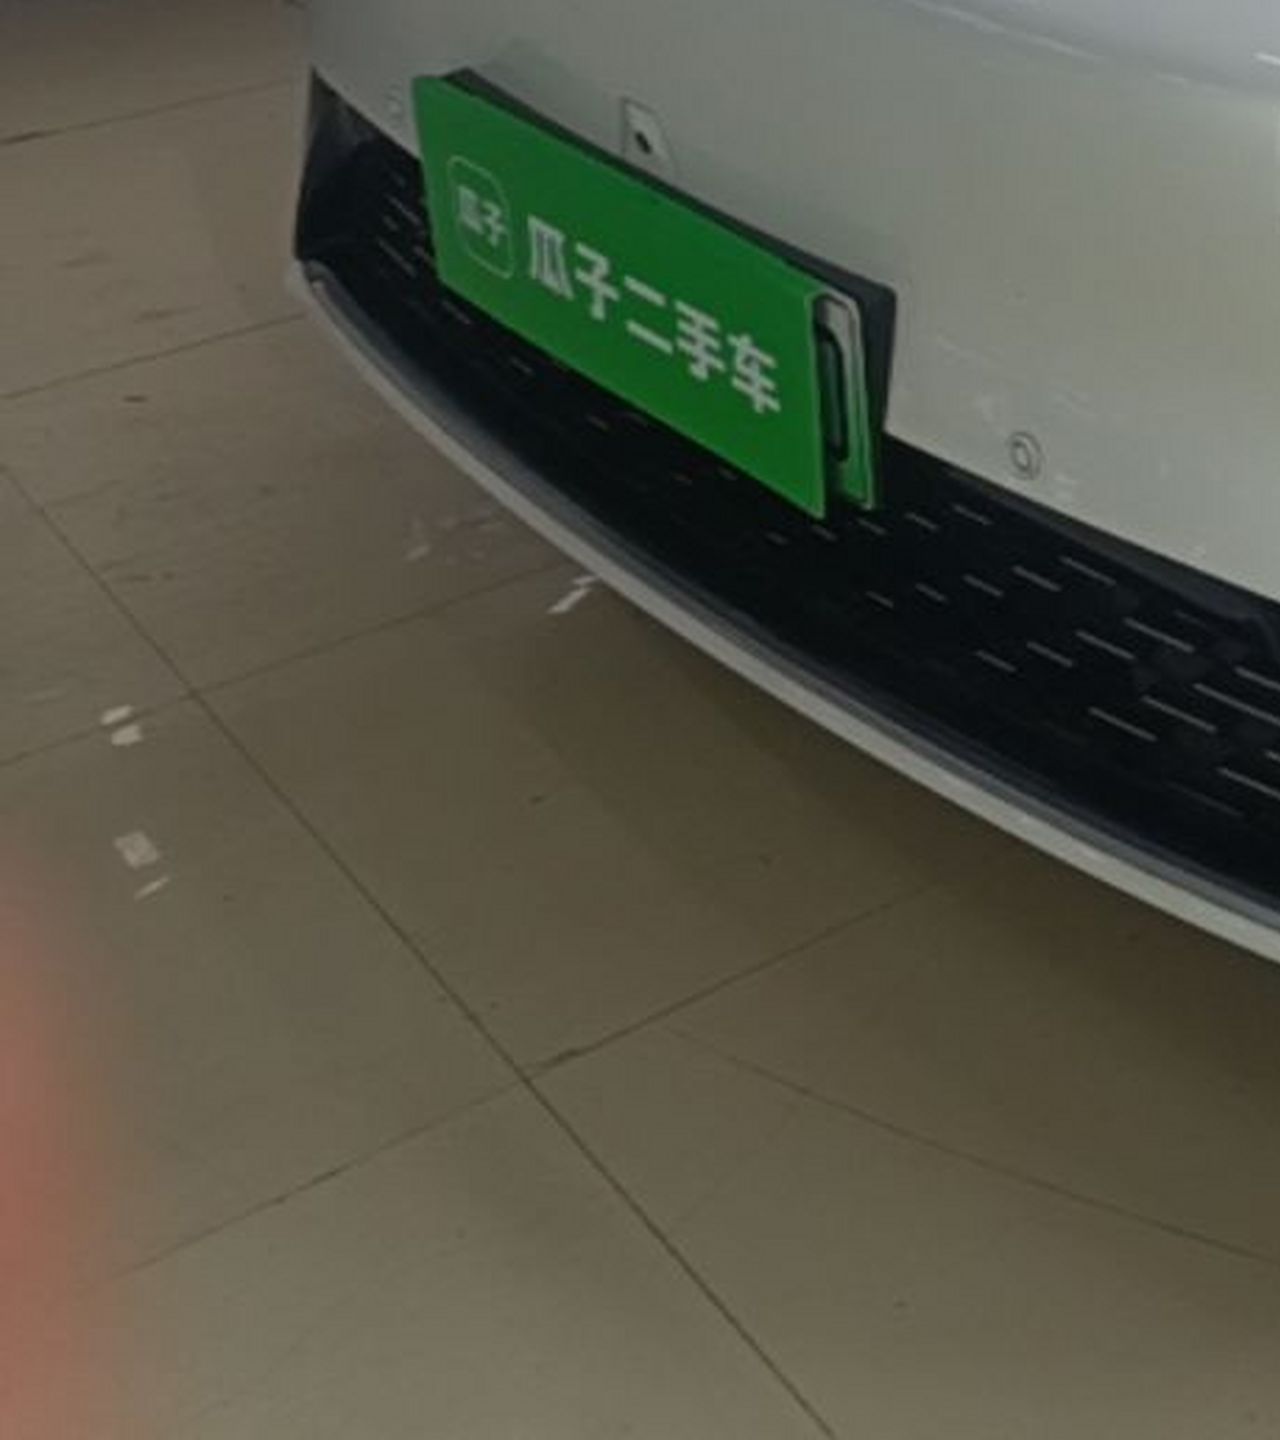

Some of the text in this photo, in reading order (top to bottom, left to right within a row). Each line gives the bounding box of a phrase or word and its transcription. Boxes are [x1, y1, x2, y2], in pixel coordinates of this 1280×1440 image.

[526, 215, 780, 414] 瓜子二手车
